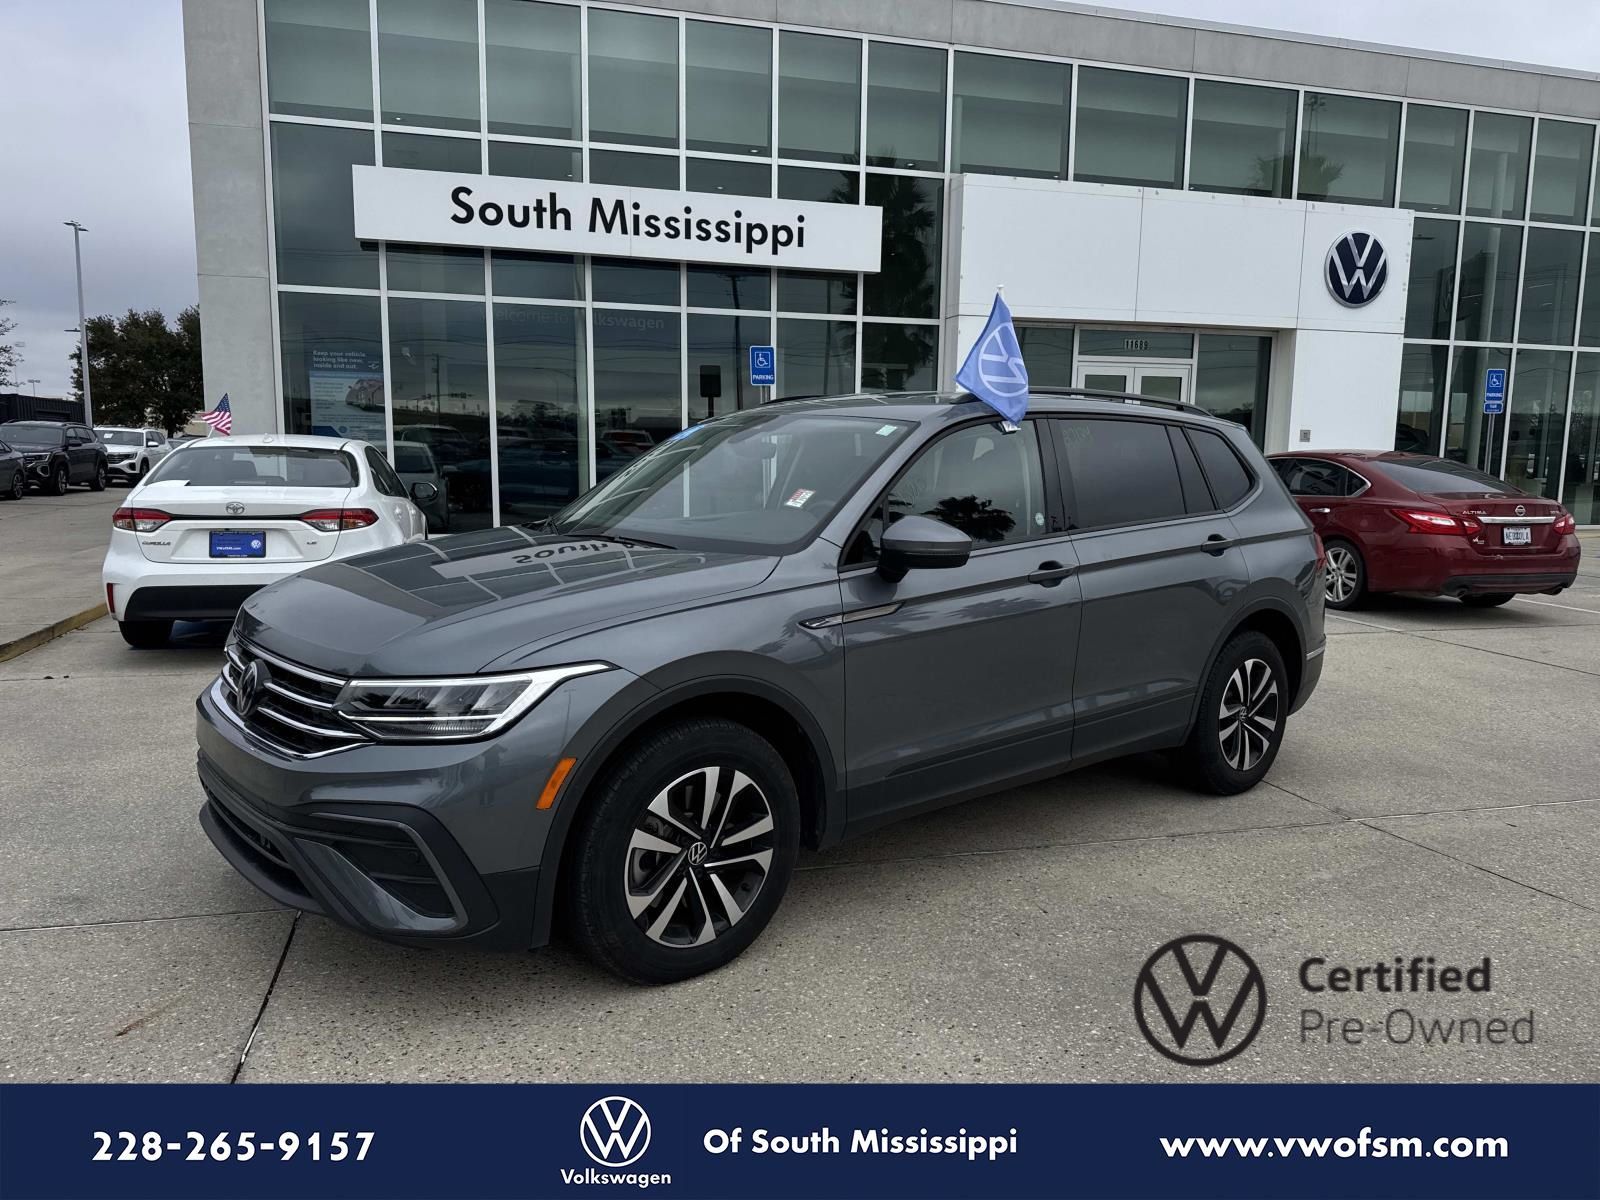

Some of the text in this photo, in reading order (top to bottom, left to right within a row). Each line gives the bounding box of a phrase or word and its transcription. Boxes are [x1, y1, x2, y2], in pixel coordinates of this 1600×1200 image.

[450, 186, 805, 256] South Mississippi
[1125, 339, 1149, 350] 11689
